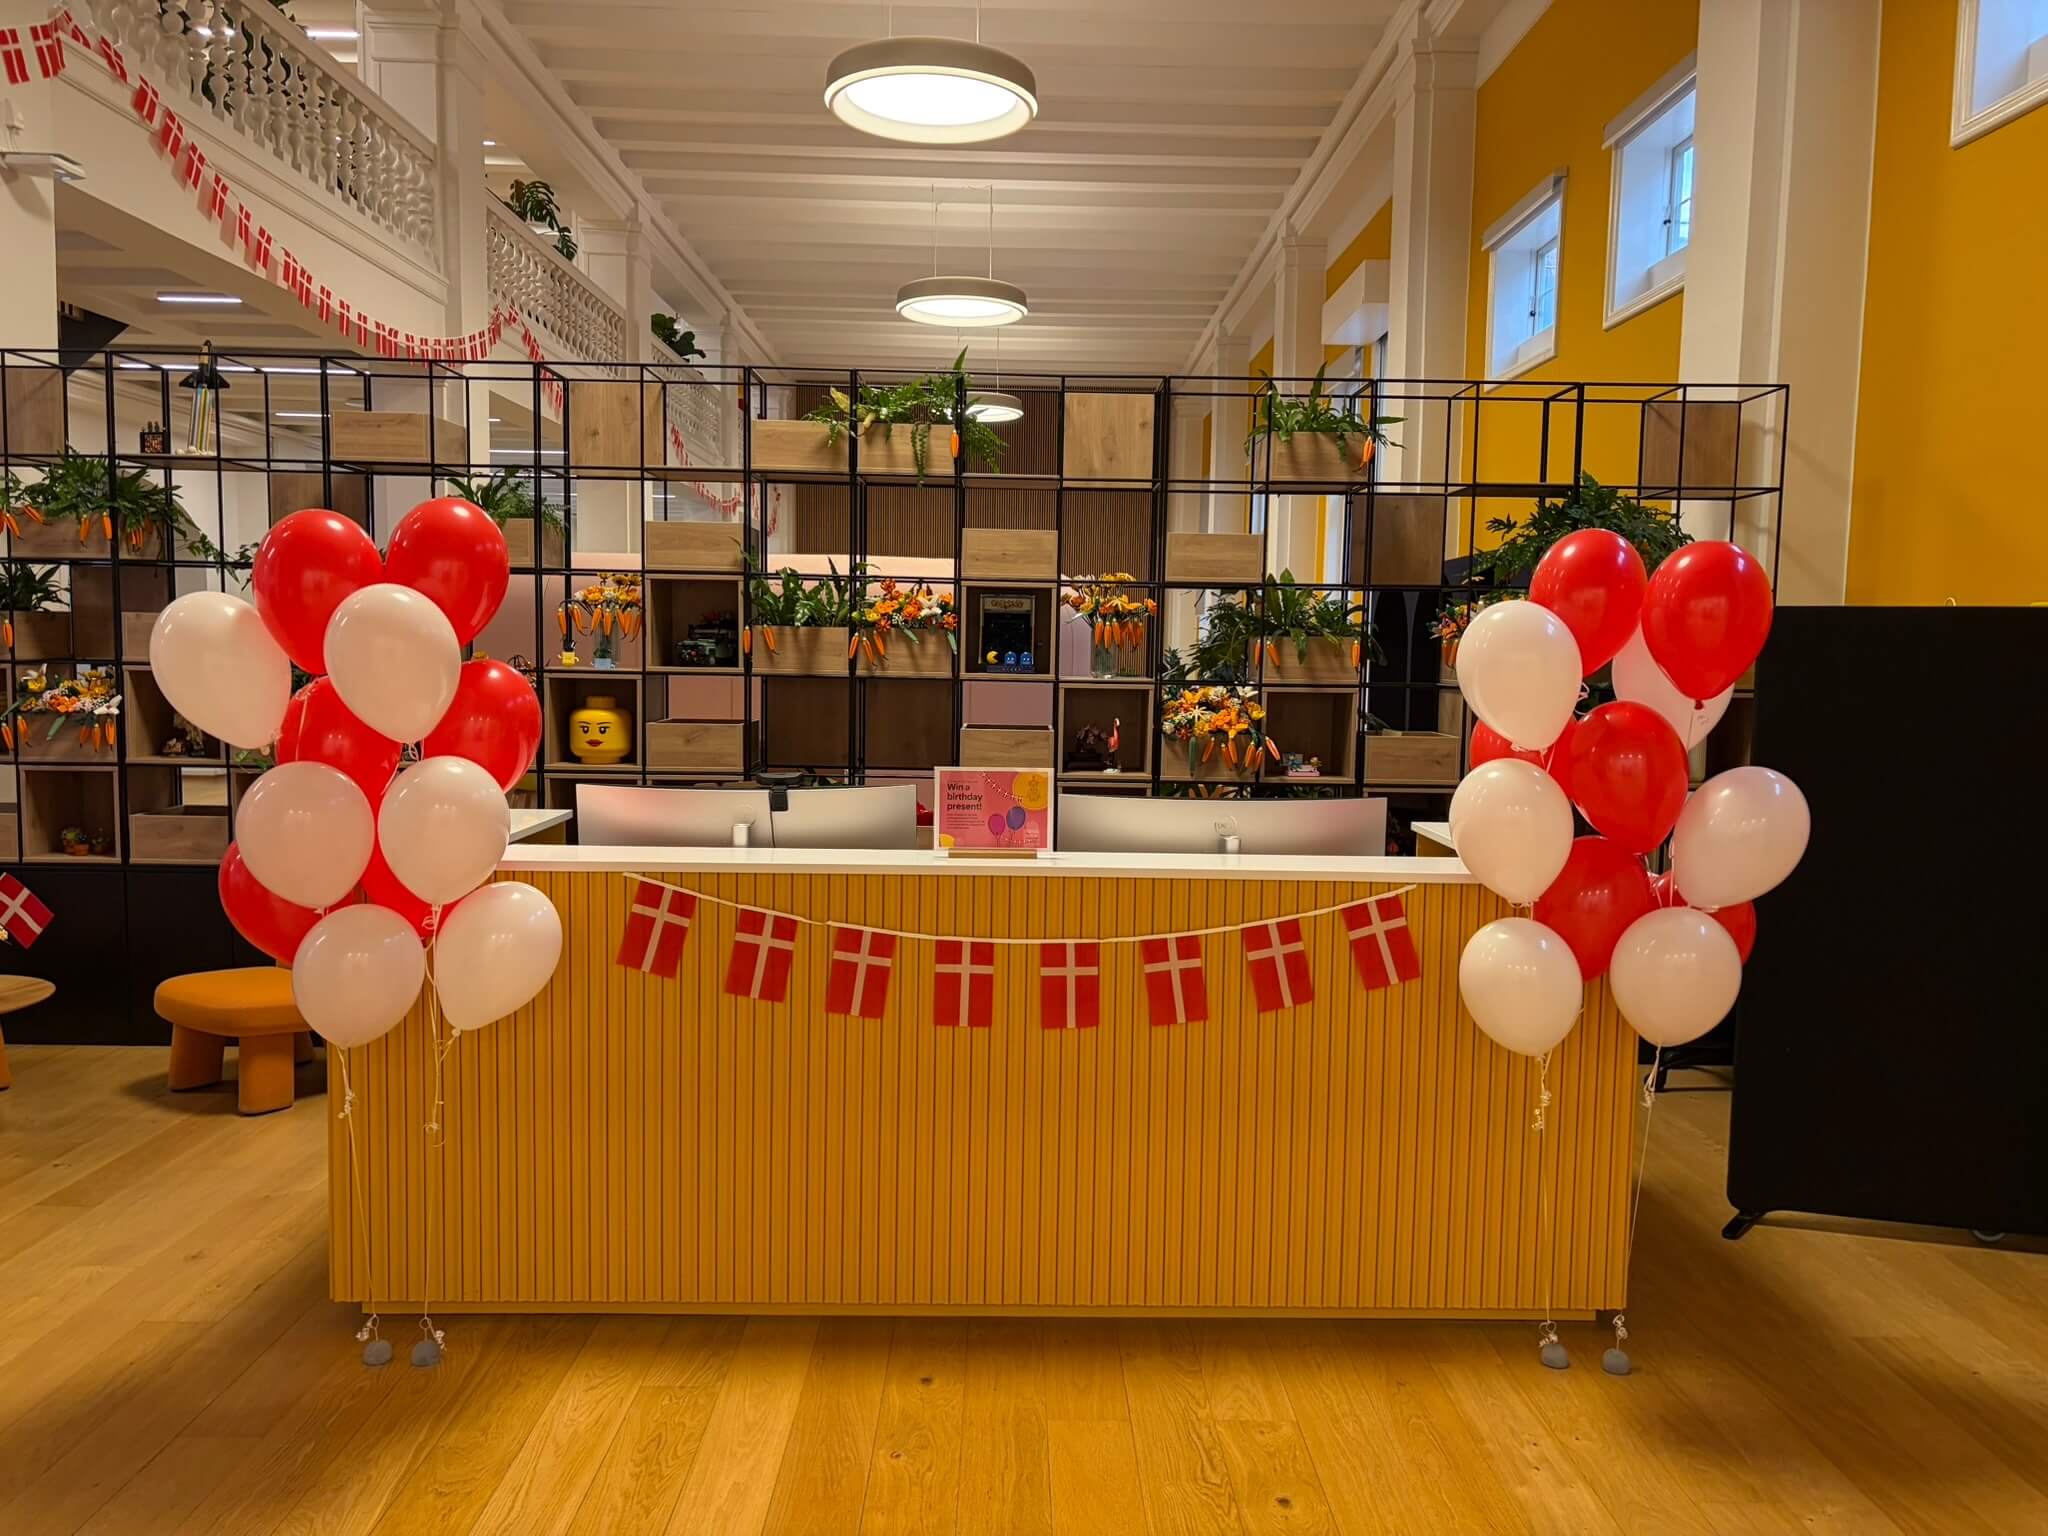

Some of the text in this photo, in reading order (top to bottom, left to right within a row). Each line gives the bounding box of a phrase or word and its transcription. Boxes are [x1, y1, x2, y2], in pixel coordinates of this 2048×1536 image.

[947, 783, 963, 791] Win
[947, 792, 983, 802] birthday
[947, 802, 982, 812] present!
